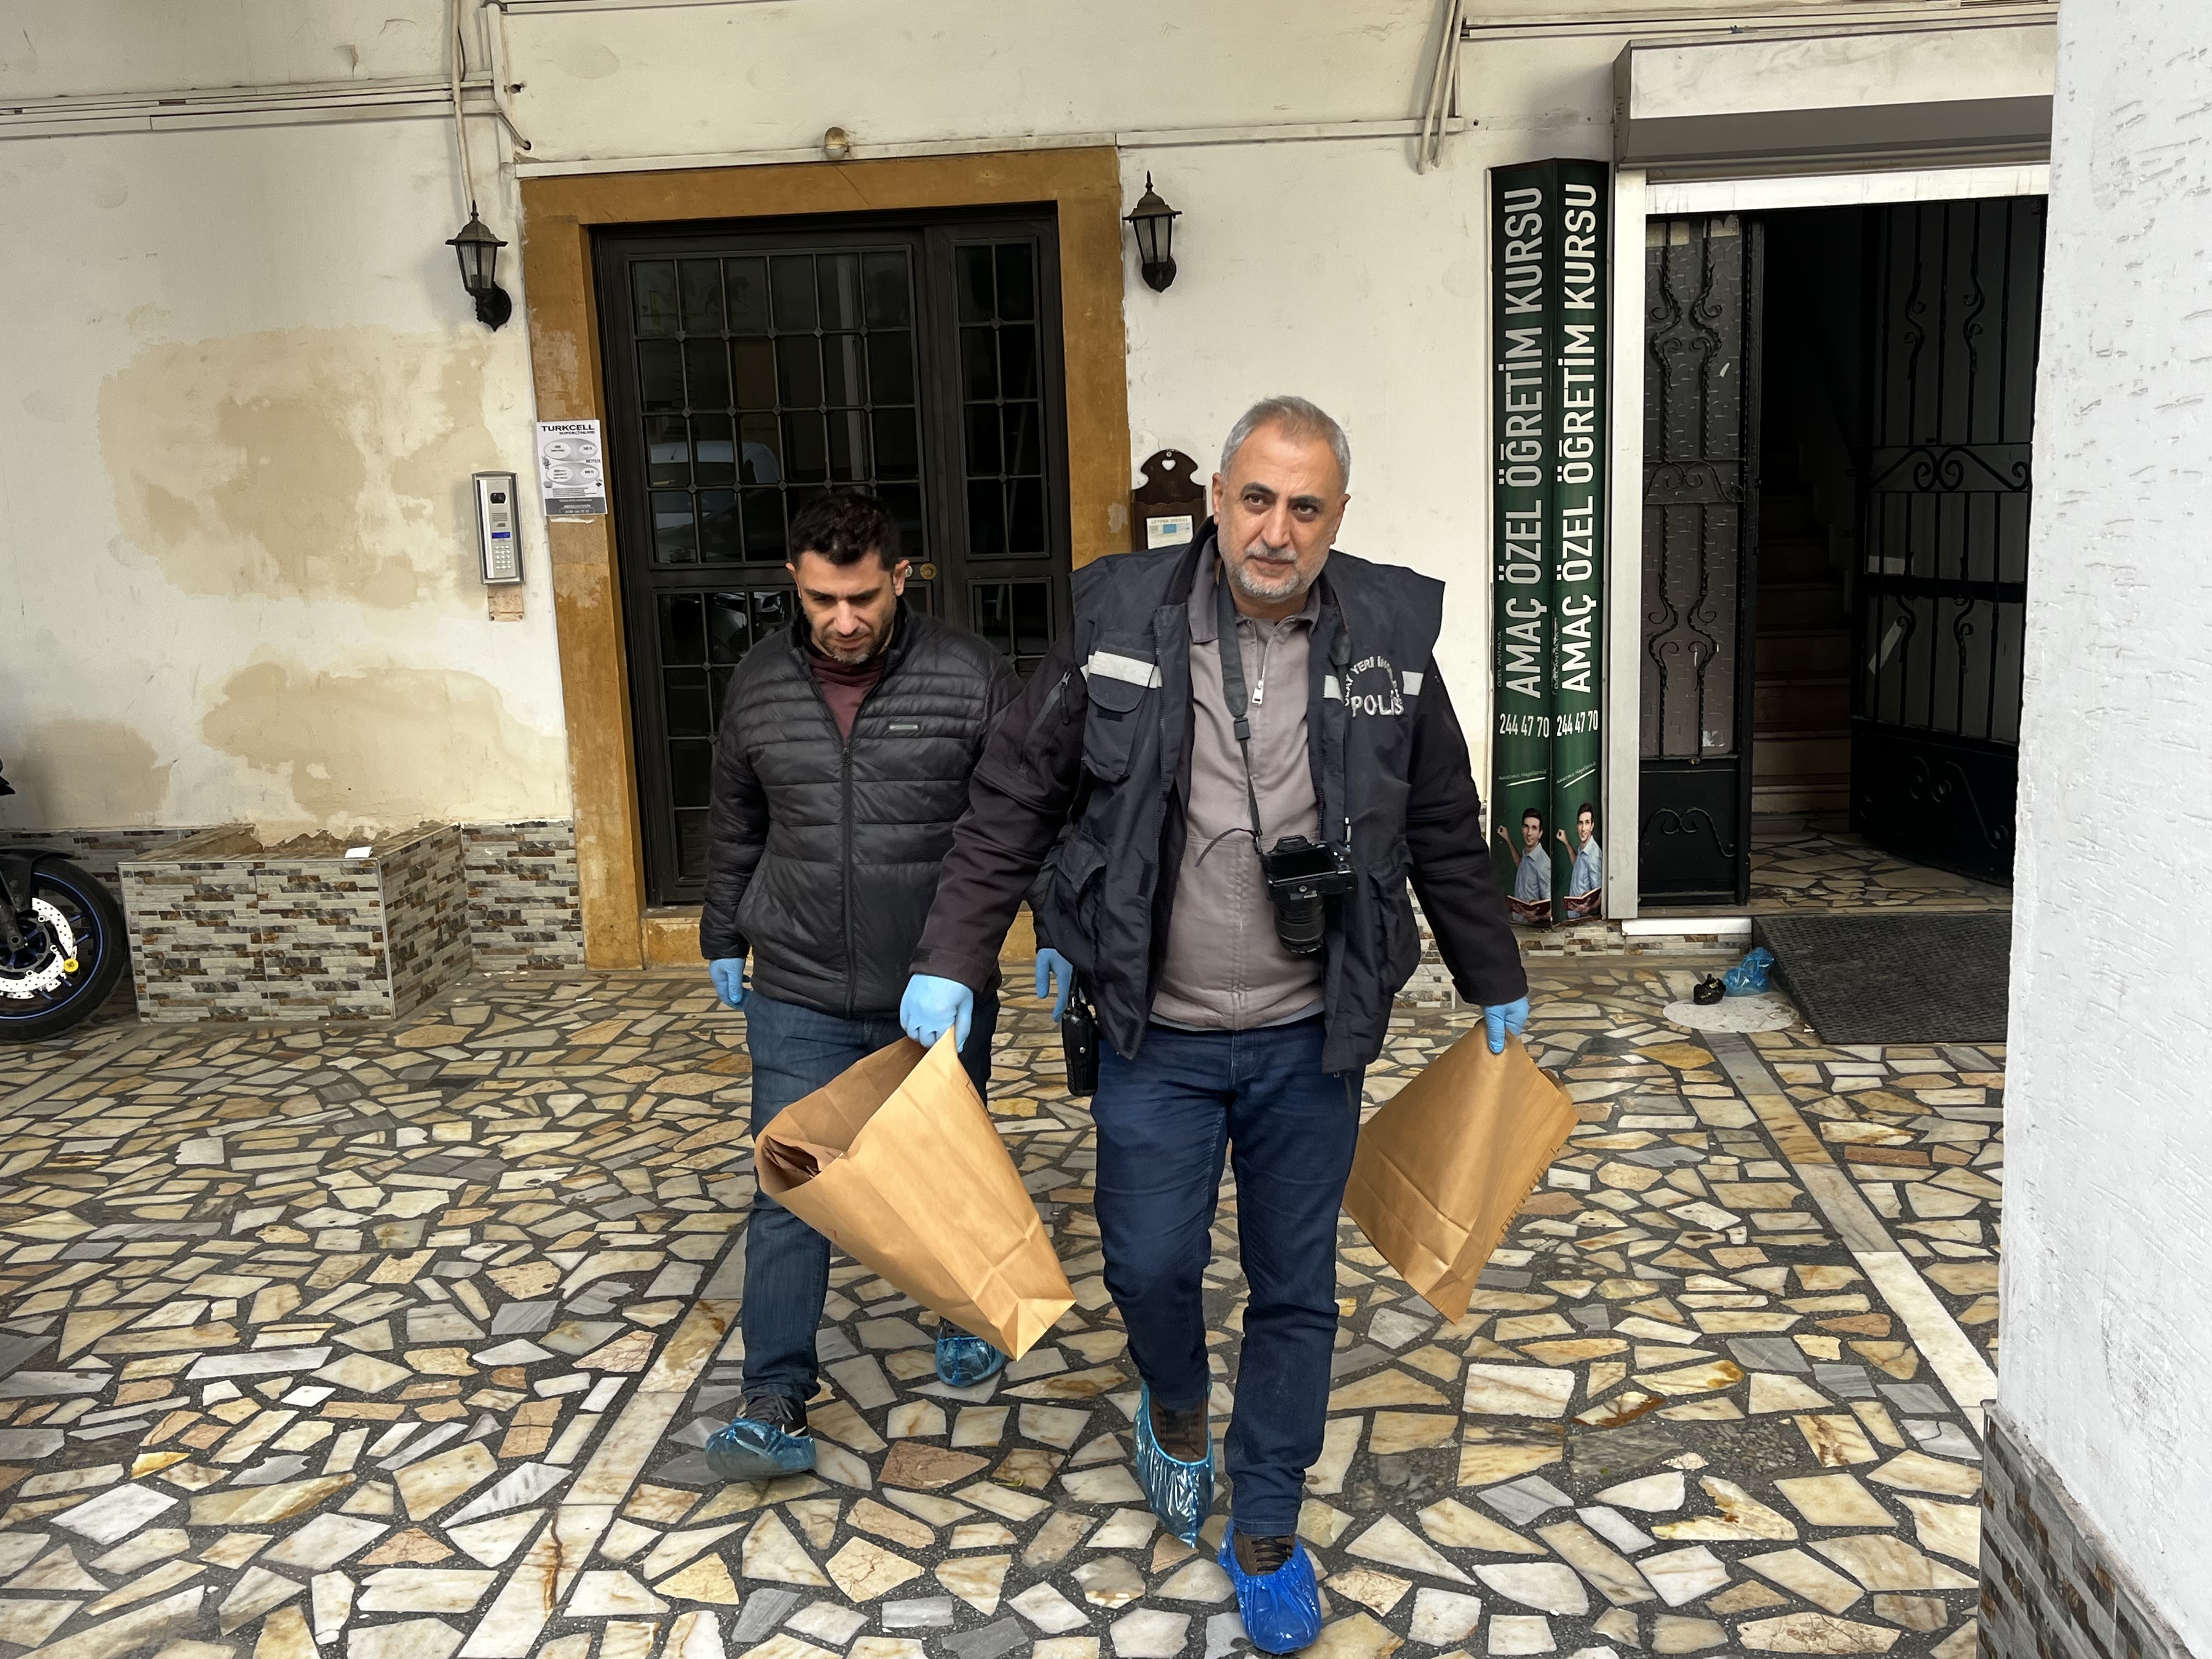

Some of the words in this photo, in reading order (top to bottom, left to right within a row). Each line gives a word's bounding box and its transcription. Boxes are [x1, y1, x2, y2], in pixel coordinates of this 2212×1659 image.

[1504, 187, 1543, 314] KURSU
[1564, 183, 1597, 309] KURSU
[540, 424, 595, 432] TURKCELL
[1498, 327, 1543, 487] ÖĞRETİM
[1556, 324, 1595, 484] ÖĞRETİM
[1498, 499, 1542, 585] ÖZEL
[1556, 495, 1594, 582] ÖZEL
[1505, 597, 1548, 699] AMAÇ
[1561, 594, 1597, 694] AMAÇ
[1499, 713, 1519, 736] 244
[1521, 715, 1534, 737] 47
[1537, 716, 1550, 738] 70
[1556, 714, 1573, 737] 244
[1575, 712, 1585, 733] 47
[1588, 709, 1599, 731] 70
